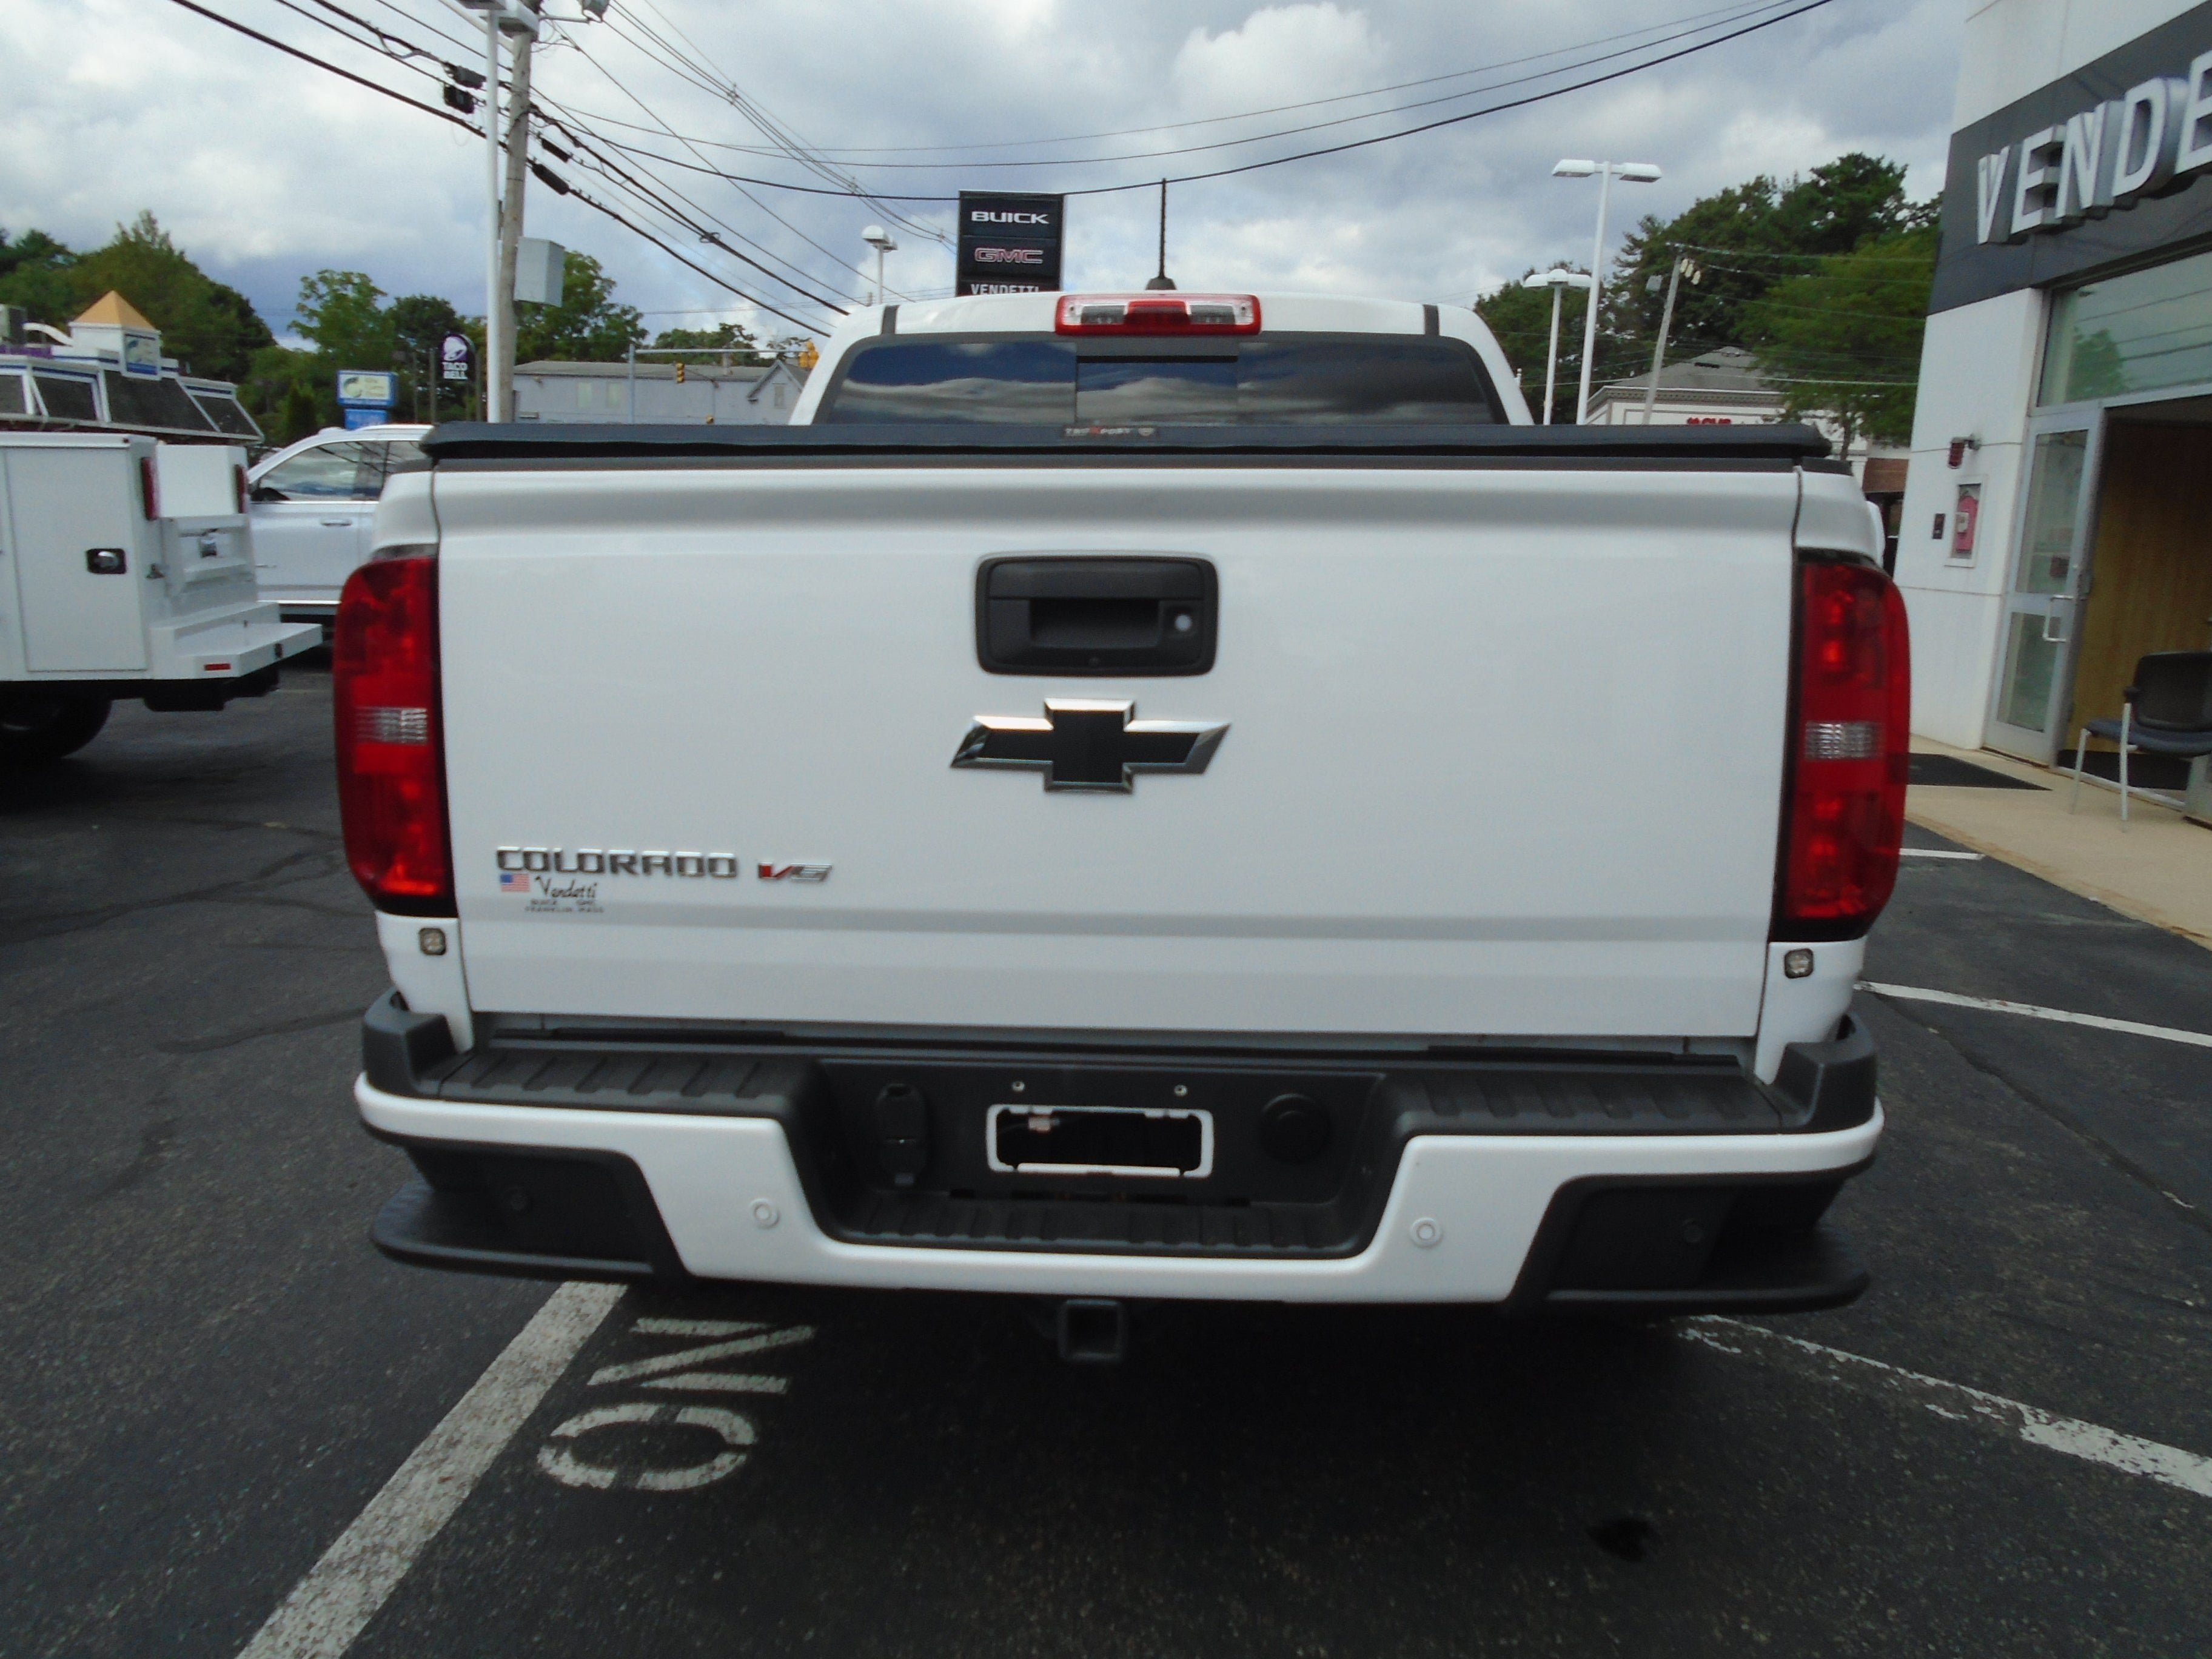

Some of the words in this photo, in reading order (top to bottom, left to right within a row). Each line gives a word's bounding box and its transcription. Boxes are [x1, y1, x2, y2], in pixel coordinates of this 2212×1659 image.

[971, 211, 1050, 224] BUICK
[974, 247, 1044, 264] GMC
[442, 362, 468, 371] TACO
[443, 370, 468, 380] BELL
[497, 846, 739, 879] COLORADO
[535, 876, 598, 898] Vendetti
